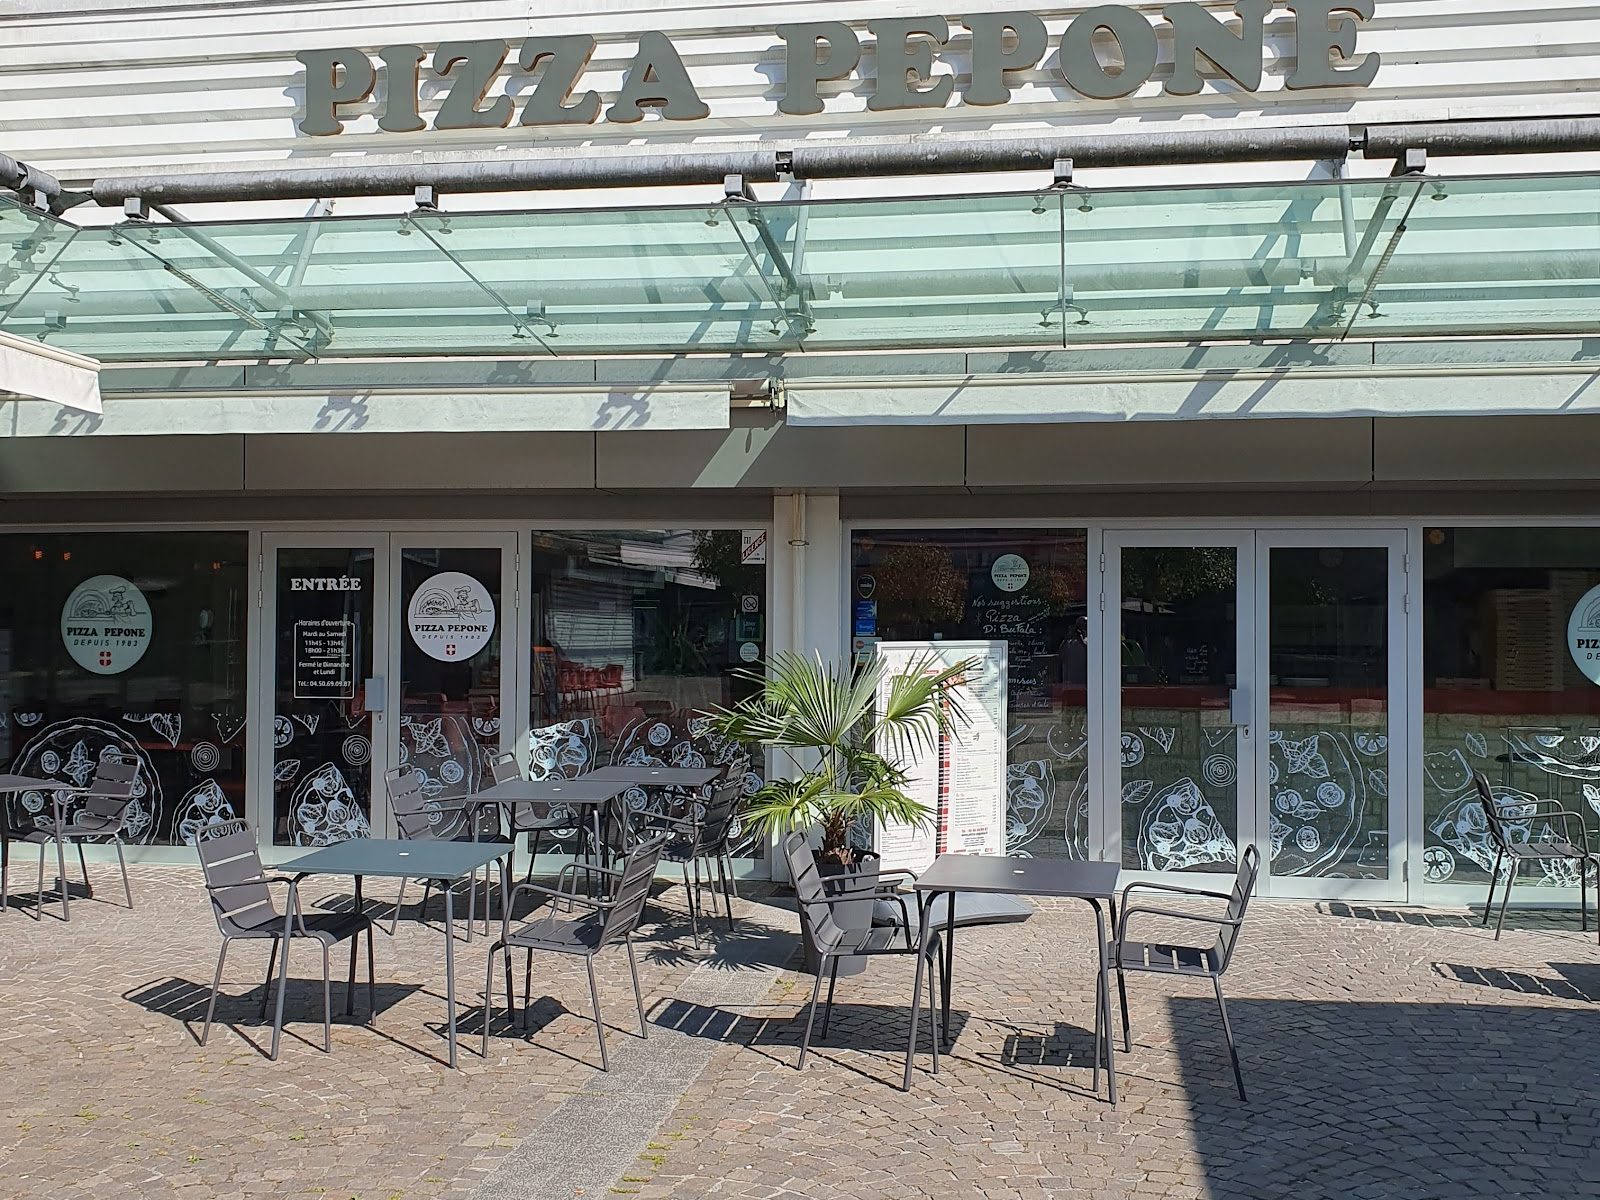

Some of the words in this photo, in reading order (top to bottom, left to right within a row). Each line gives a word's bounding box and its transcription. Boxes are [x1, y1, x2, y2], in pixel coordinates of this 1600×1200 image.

[296, 31, 710, 136] PIZZA
[776, 0, 1381, 116] PEPONE
[290, 574, 362, 591] ENTRÉE
[972, 595, 986, 608] Nos
[985, 609, 1022, 623] Pizza
[298, 619, 321, 627] Horaires
[321, 619, 352, 627] d'ouverture
[66, 627, 98, 637] PIZZA
[104, 627, 146, 638] PEPONE
[415, 624, 445, 632] PIZZA
[447, 624, 489, 633] PEPONE
[983, 624, 997, 634] Di
[73, 639, 110, 647] DEPUIS
[304, 639, 323, 647] 11h45
[326, 639, 345, 647] 13h45
